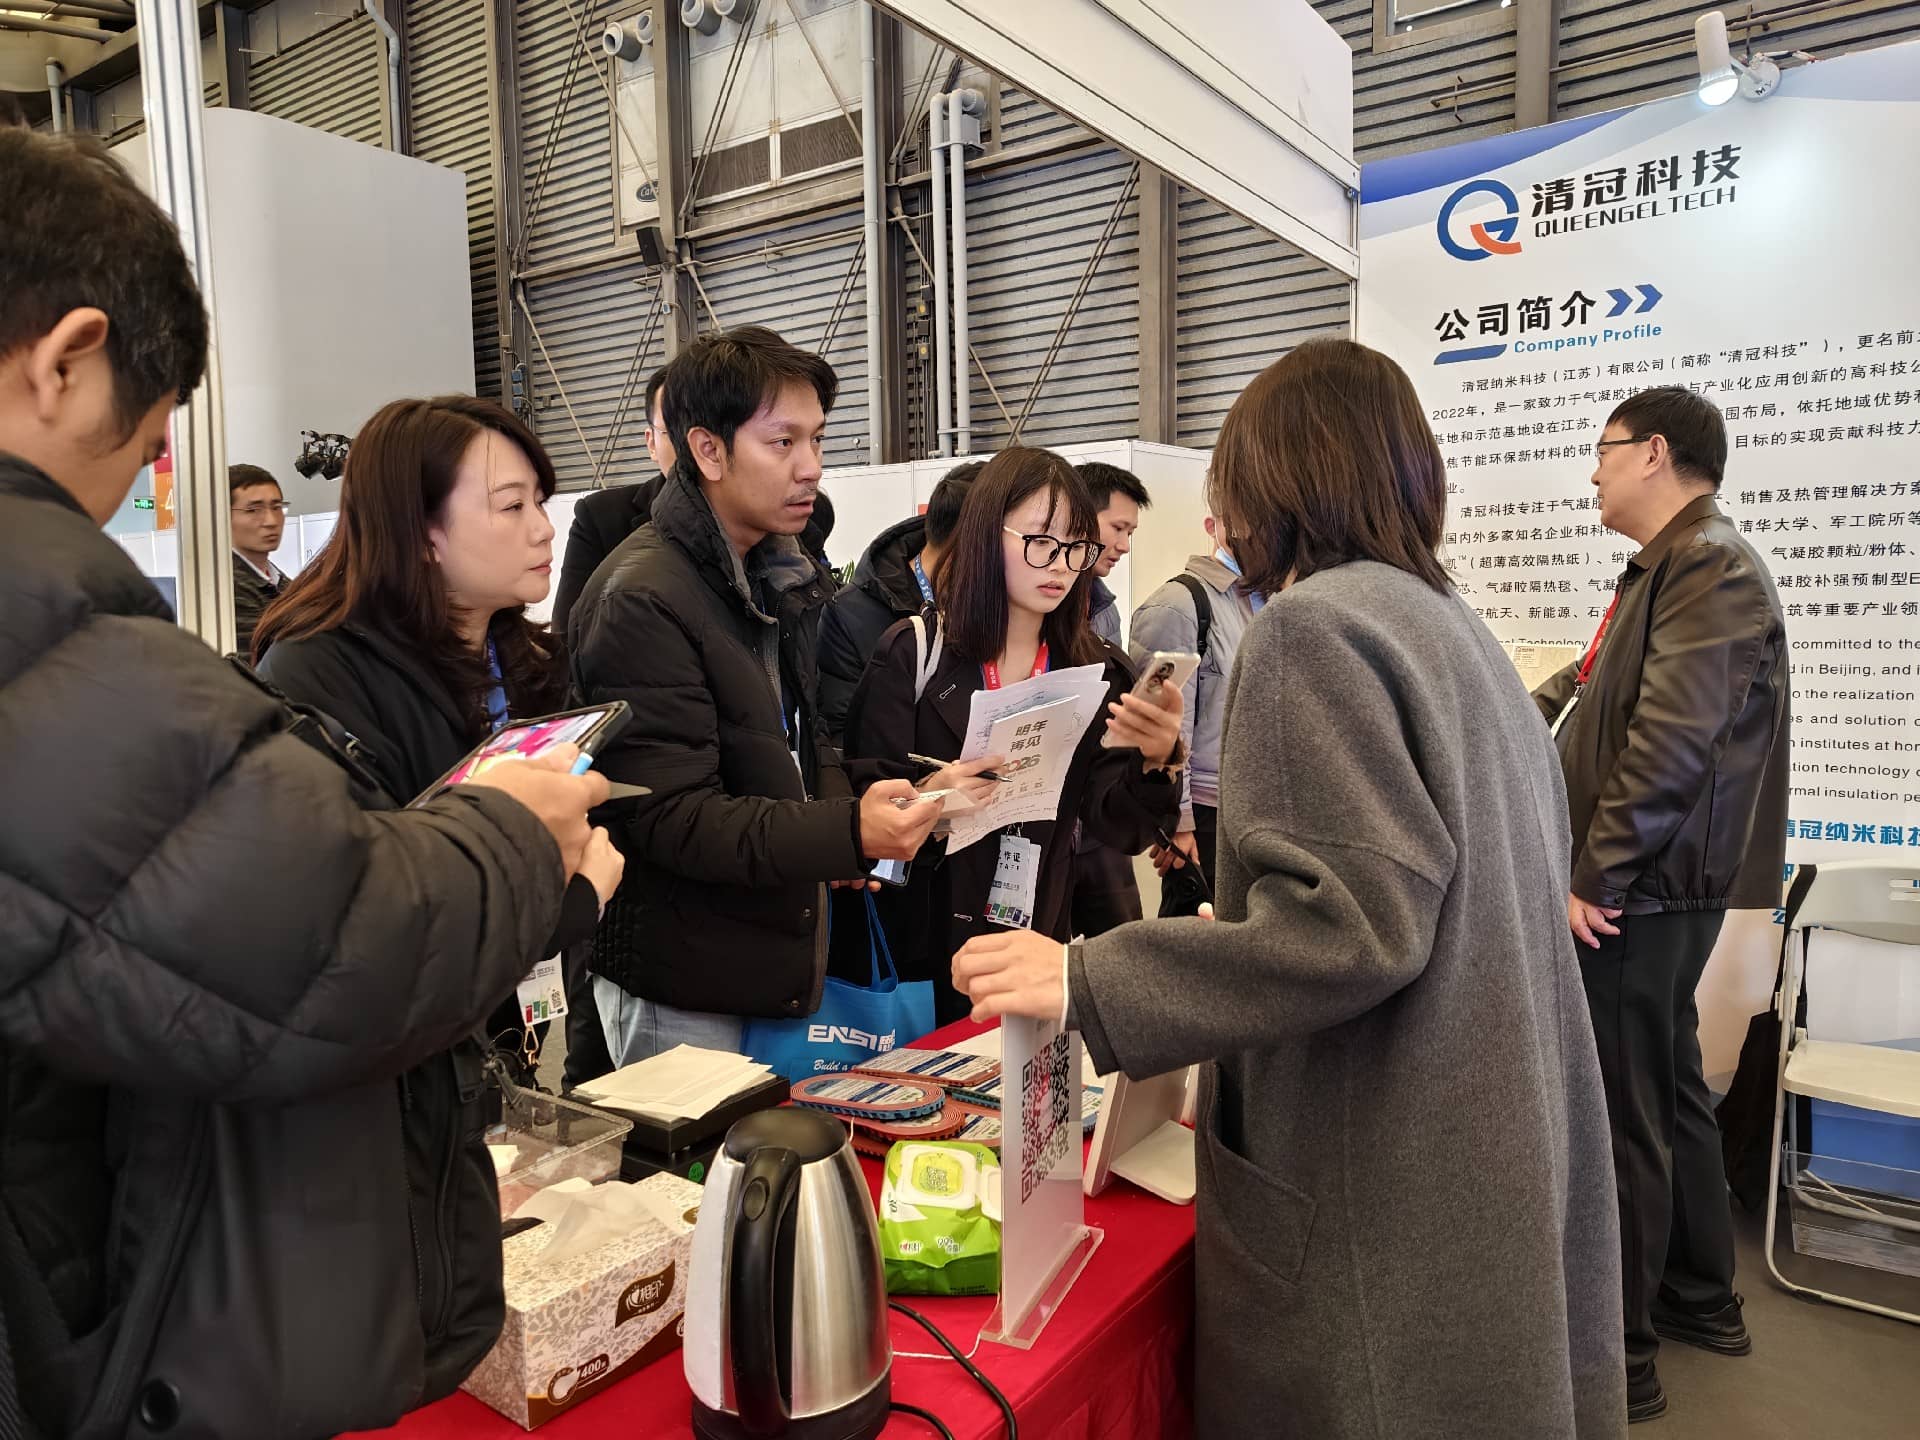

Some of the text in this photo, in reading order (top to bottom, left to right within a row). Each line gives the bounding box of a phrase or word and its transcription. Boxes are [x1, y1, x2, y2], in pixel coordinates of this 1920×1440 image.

[1531, 144, 1741, 217] 清冠科技
[1434, 290, 1597, 342] 公司简介
[1514, 323, 1662, 353] Company Profile
[1446, 443, 1601, 469] 焦节能环保新材料的研
[1781, 601, 1919, 617] 筑等重要产业领
[1792, 638, 1872, 650] committed
[1878, 639, 1892, 650] to
[1801, 664, 1814, 675] in
[1819, 663, 1876, 677] Beijing,
[1881, 664, 1911, 676] and
[1805, 689, 1828, 699] the
[1833, 690, 1914, 701] realization
[1810, 714, 1838, 724] and
[1845, 714, 1906, 726] solution
[1015, 720, 1048, 736] 明年
[1010, 735, 1042, 752] 再见
[1800, 738, 1869, 750] institutes
[1874, 741, 1889, 751] at
[1825, 763, 1910, 778] technology
[1824, 786, 1899, 801] insulation
